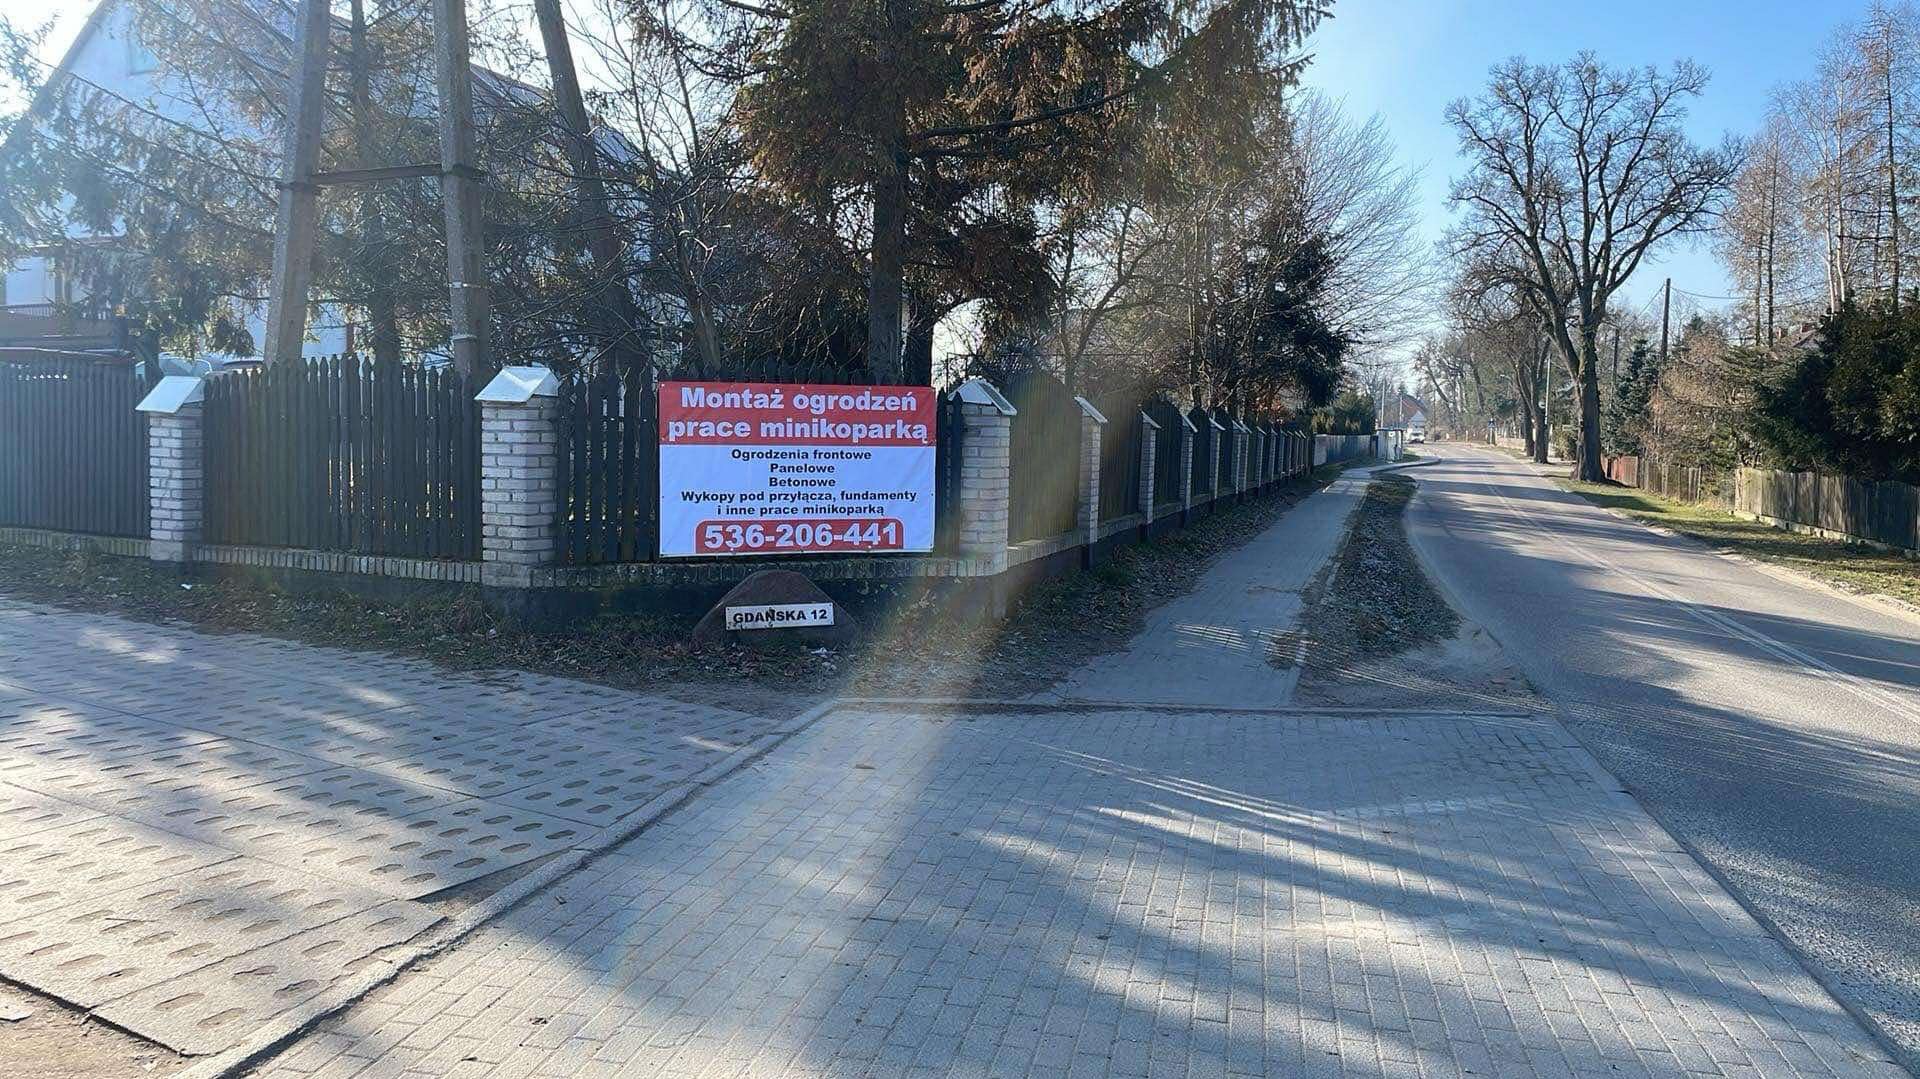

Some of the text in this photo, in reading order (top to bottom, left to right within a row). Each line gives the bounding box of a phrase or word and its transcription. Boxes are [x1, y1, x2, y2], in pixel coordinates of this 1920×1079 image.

[681, 387, 917, 415] Montaż ogrodzeń
[668, 418, 928, 443] prace minikoparką
[731, 449, 872, 461] Ogrodzenia frontowe
[770, 463, 835, 473] Panelowe
[769, 477, 836, 487] Betonowe
[681, 490, 917, 504] Wykopy pod przyłącza, fundamenty
[717, 504, 884, 517] i inne prace minikoparką
[704, 522, 897, 549] 536-206-441
[811, 609, 828, 620] 12
